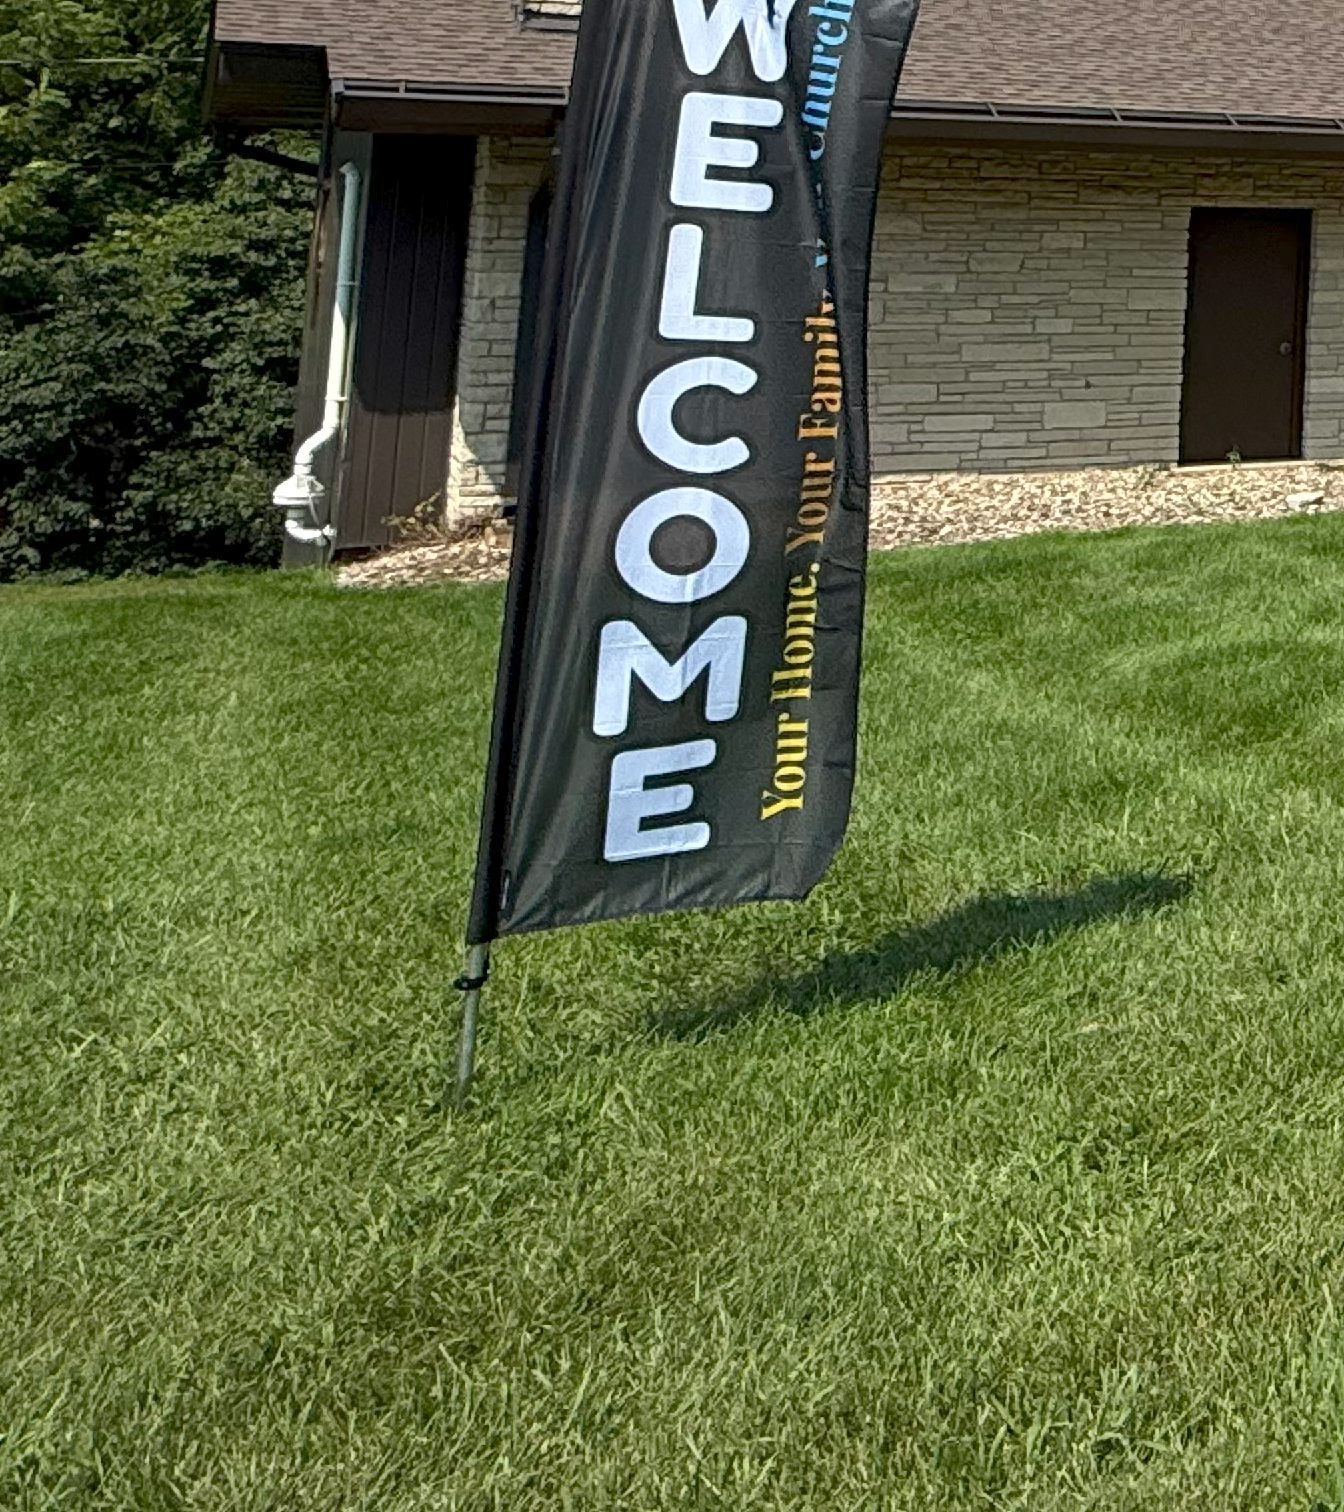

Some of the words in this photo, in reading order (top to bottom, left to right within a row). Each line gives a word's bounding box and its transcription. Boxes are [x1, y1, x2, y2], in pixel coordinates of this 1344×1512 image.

[797, 288, 842, 441] Famil
[784, 453, 835, 552] Your
[771, 561, 821, 701] Home.
[760, 714, 809, 820] Your
